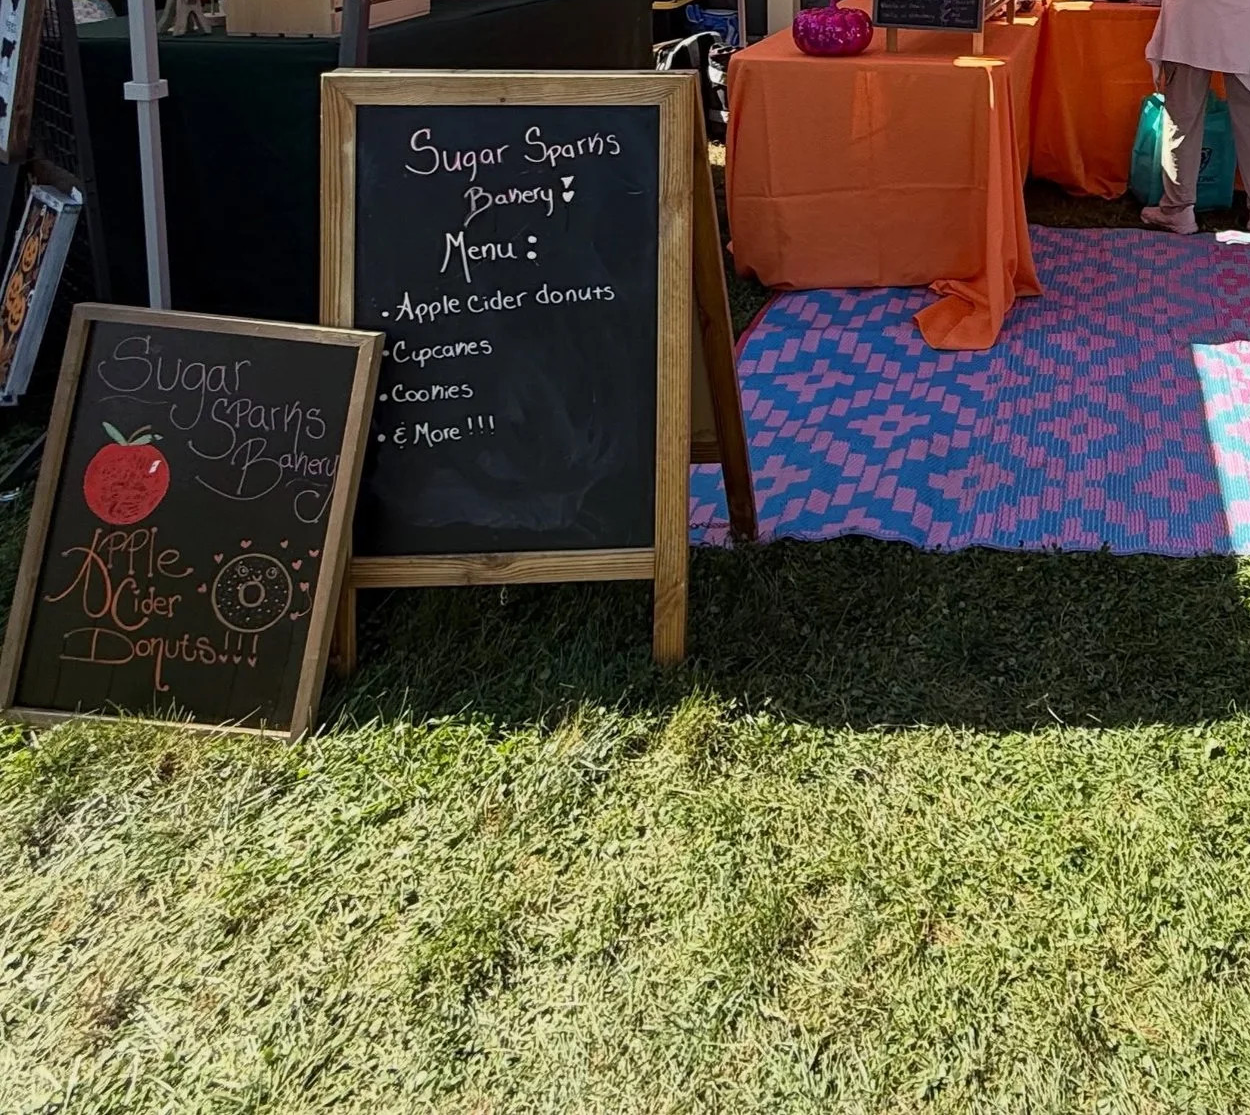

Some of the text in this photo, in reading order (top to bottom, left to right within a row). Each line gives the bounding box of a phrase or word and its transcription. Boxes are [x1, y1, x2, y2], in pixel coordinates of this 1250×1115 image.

[405, 128, 510, 181] Sugar
[395, 284, 615, 324] Apple Cider donuts
[98, 335, 251, 430] Sugar
[111, 577, 182, 631] Cider
